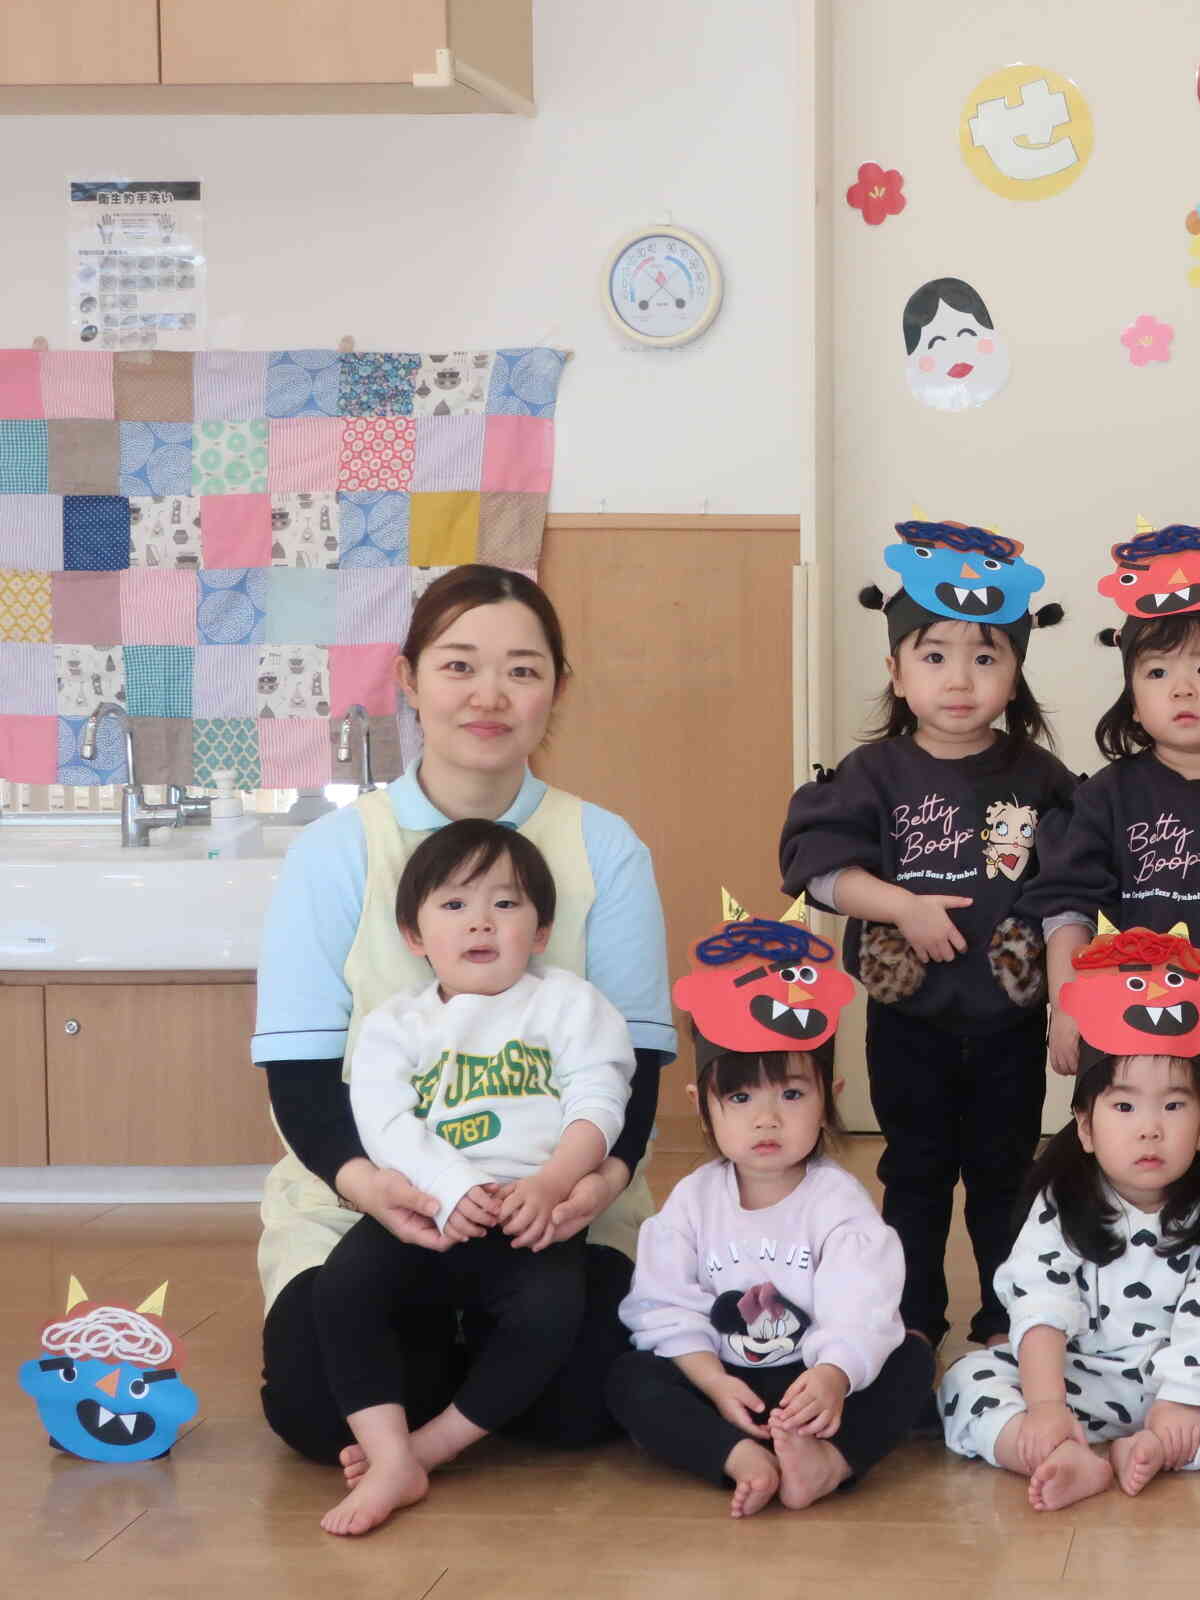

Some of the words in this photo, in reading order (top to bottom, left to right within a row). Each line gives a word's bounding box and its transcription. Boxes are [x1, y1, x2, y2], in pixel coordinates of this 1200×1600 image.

[890, 793, 960, 840] Betty
[1126, 812, 1194, 855] Betty
[900, 830, 974, 866] Boop
[945, 867, 978, 882] Symbol
